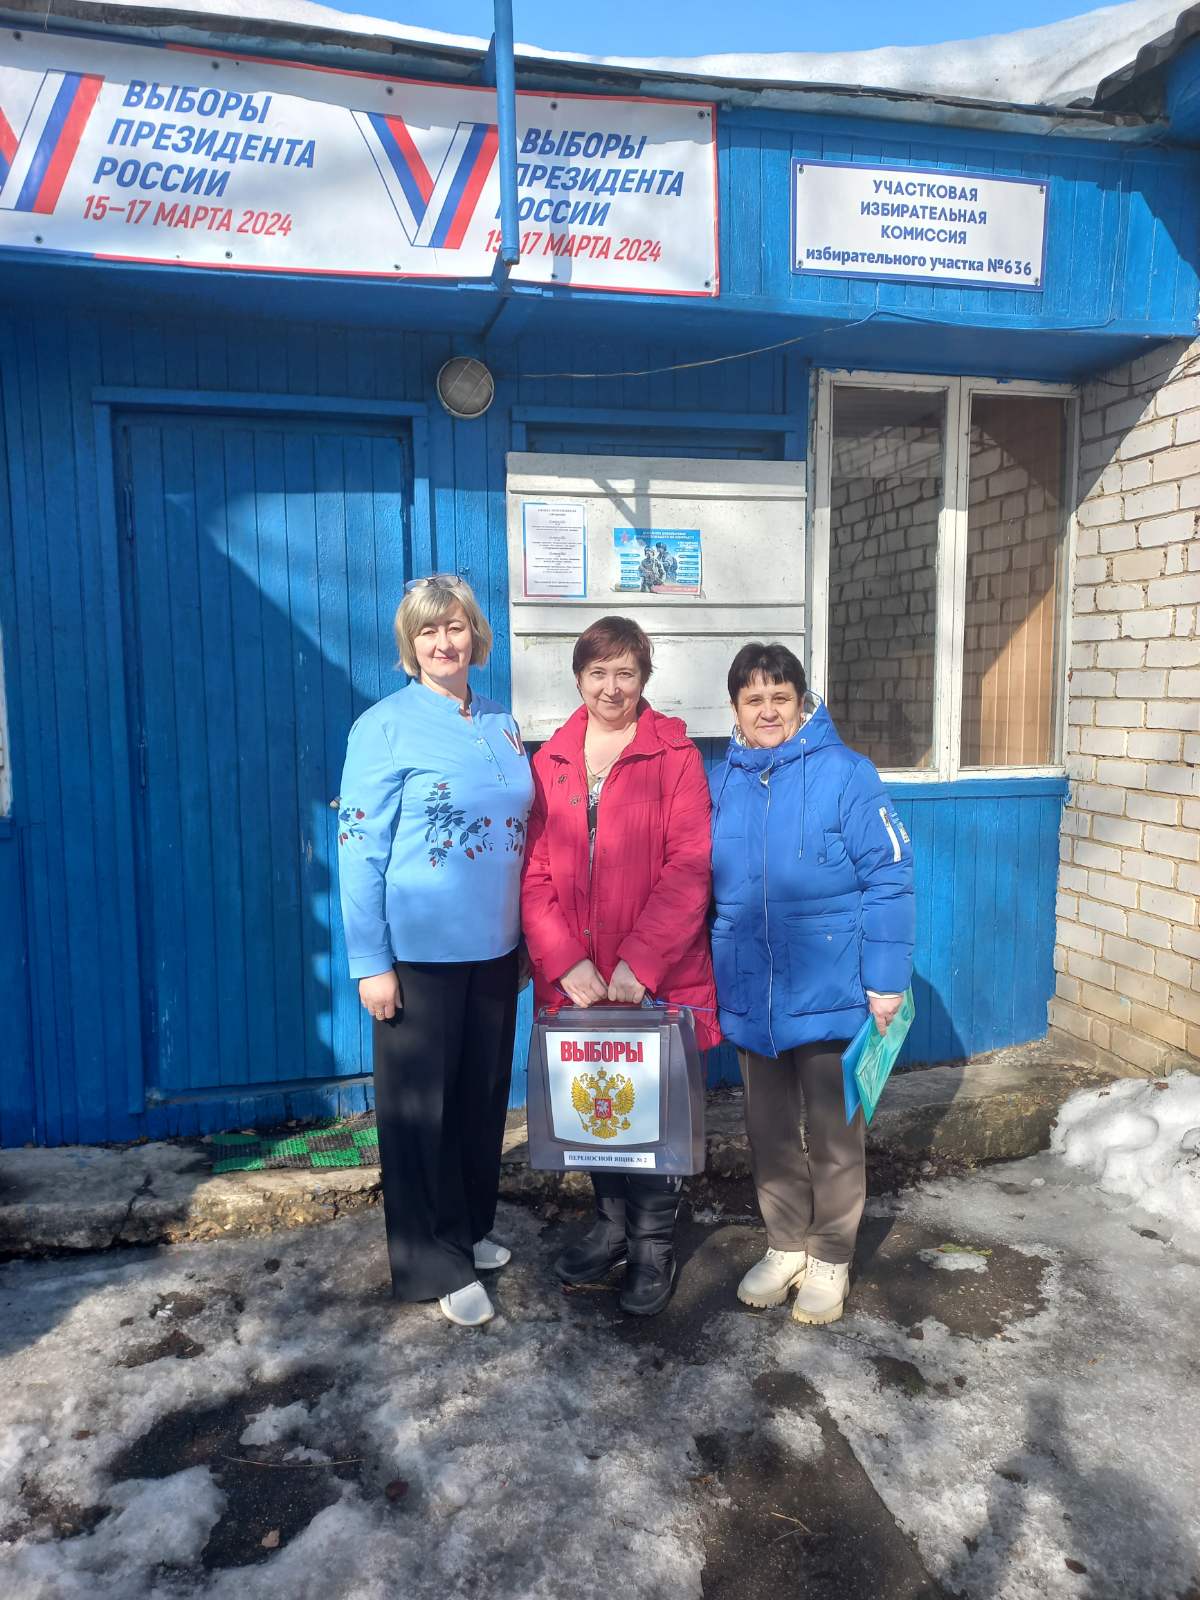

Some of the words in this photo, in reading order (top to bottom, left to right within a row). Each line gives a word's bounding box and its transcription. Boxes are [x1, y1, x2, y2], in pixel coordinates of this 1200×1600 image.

[122, 79, 272, 124] ВЫБОРЫ
[107, 118, 316, 169] ПРЕЗИДЕНТА
[519, 127, 647, 160] ВЫБОРЫ
[92, 156, 231, 198] РОССИИ
[873, 179, 978, 202] УЧАСТКОВАЯ
[152, 201, 232, 232] МАРТА
[237, 210, 293, 237] 2024
[495, 197, 611, 226] ОССИИ
[860, 201, 987, 225] ИЗБИРАТЕЛЬНАЯ
[543, 232, 611, 260] МАРТА
[614, 238, 662, 262] 2024
[881, 224, 967, 245] КОМИССИЯ
[806, 247, 926, 267] избирательного
[930, 255, 984, 272] участка
[987, 257, 1032, 276] №636
[560, 1041, 644, 1063] ВЫБОРЫ
